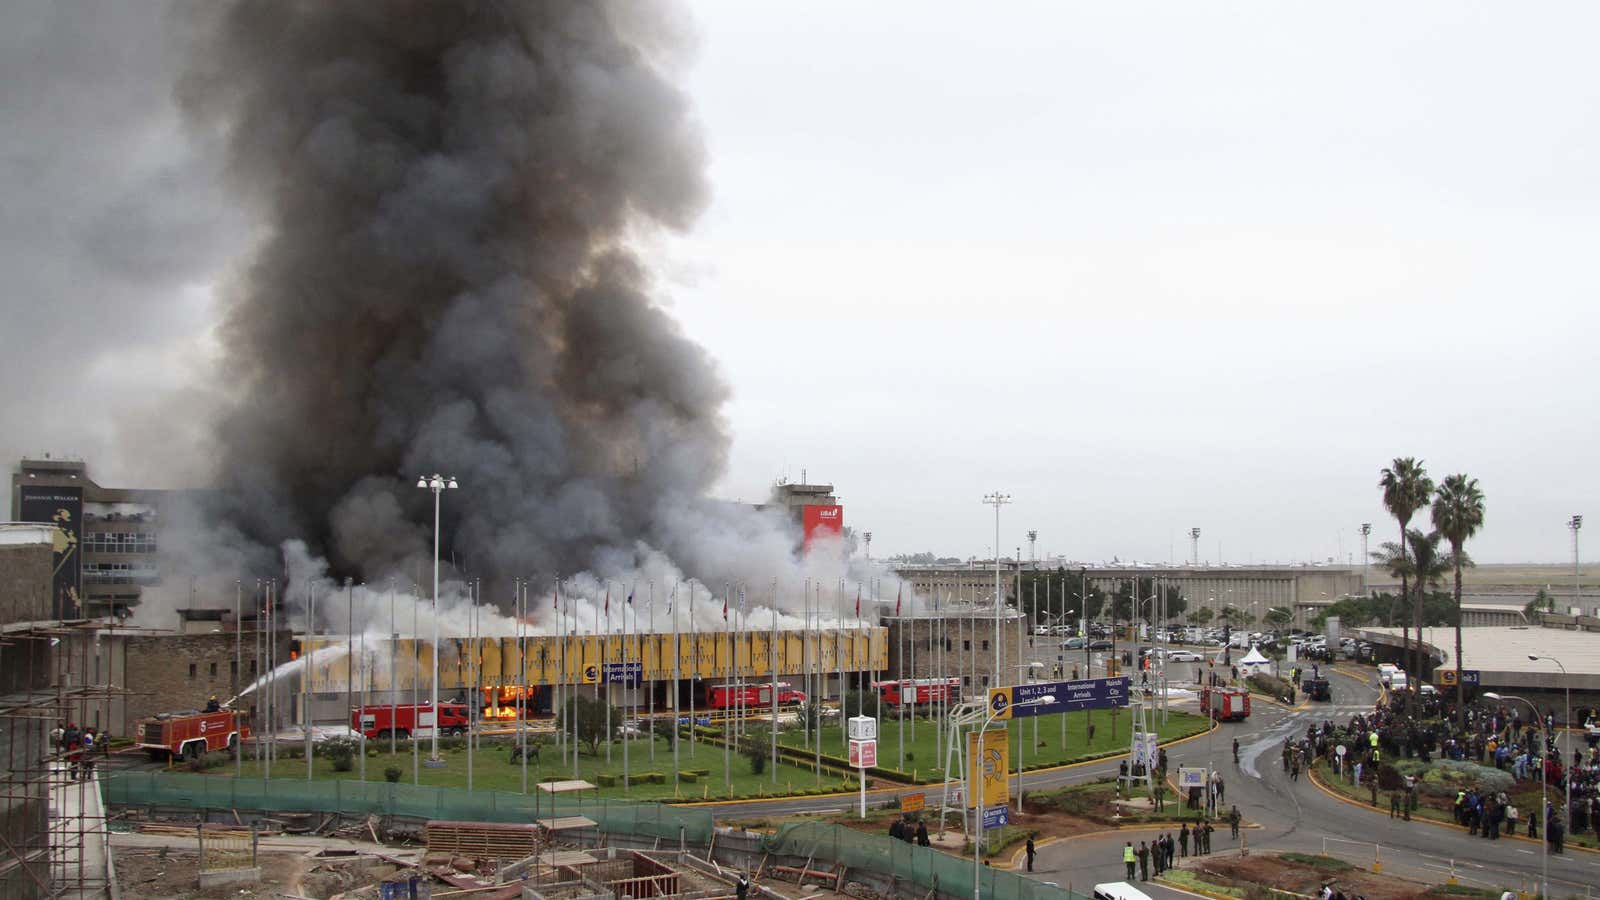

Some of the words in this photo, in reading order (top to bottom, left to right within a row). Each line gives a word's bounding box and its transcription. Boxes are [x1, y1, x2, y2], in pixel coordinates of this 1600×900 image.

[603, 664, 641, 673] Internaional
[1067, 681, 1096, 691] International
[138, 724, 146, 736] 5
[200, 721, 207, 733] 5
